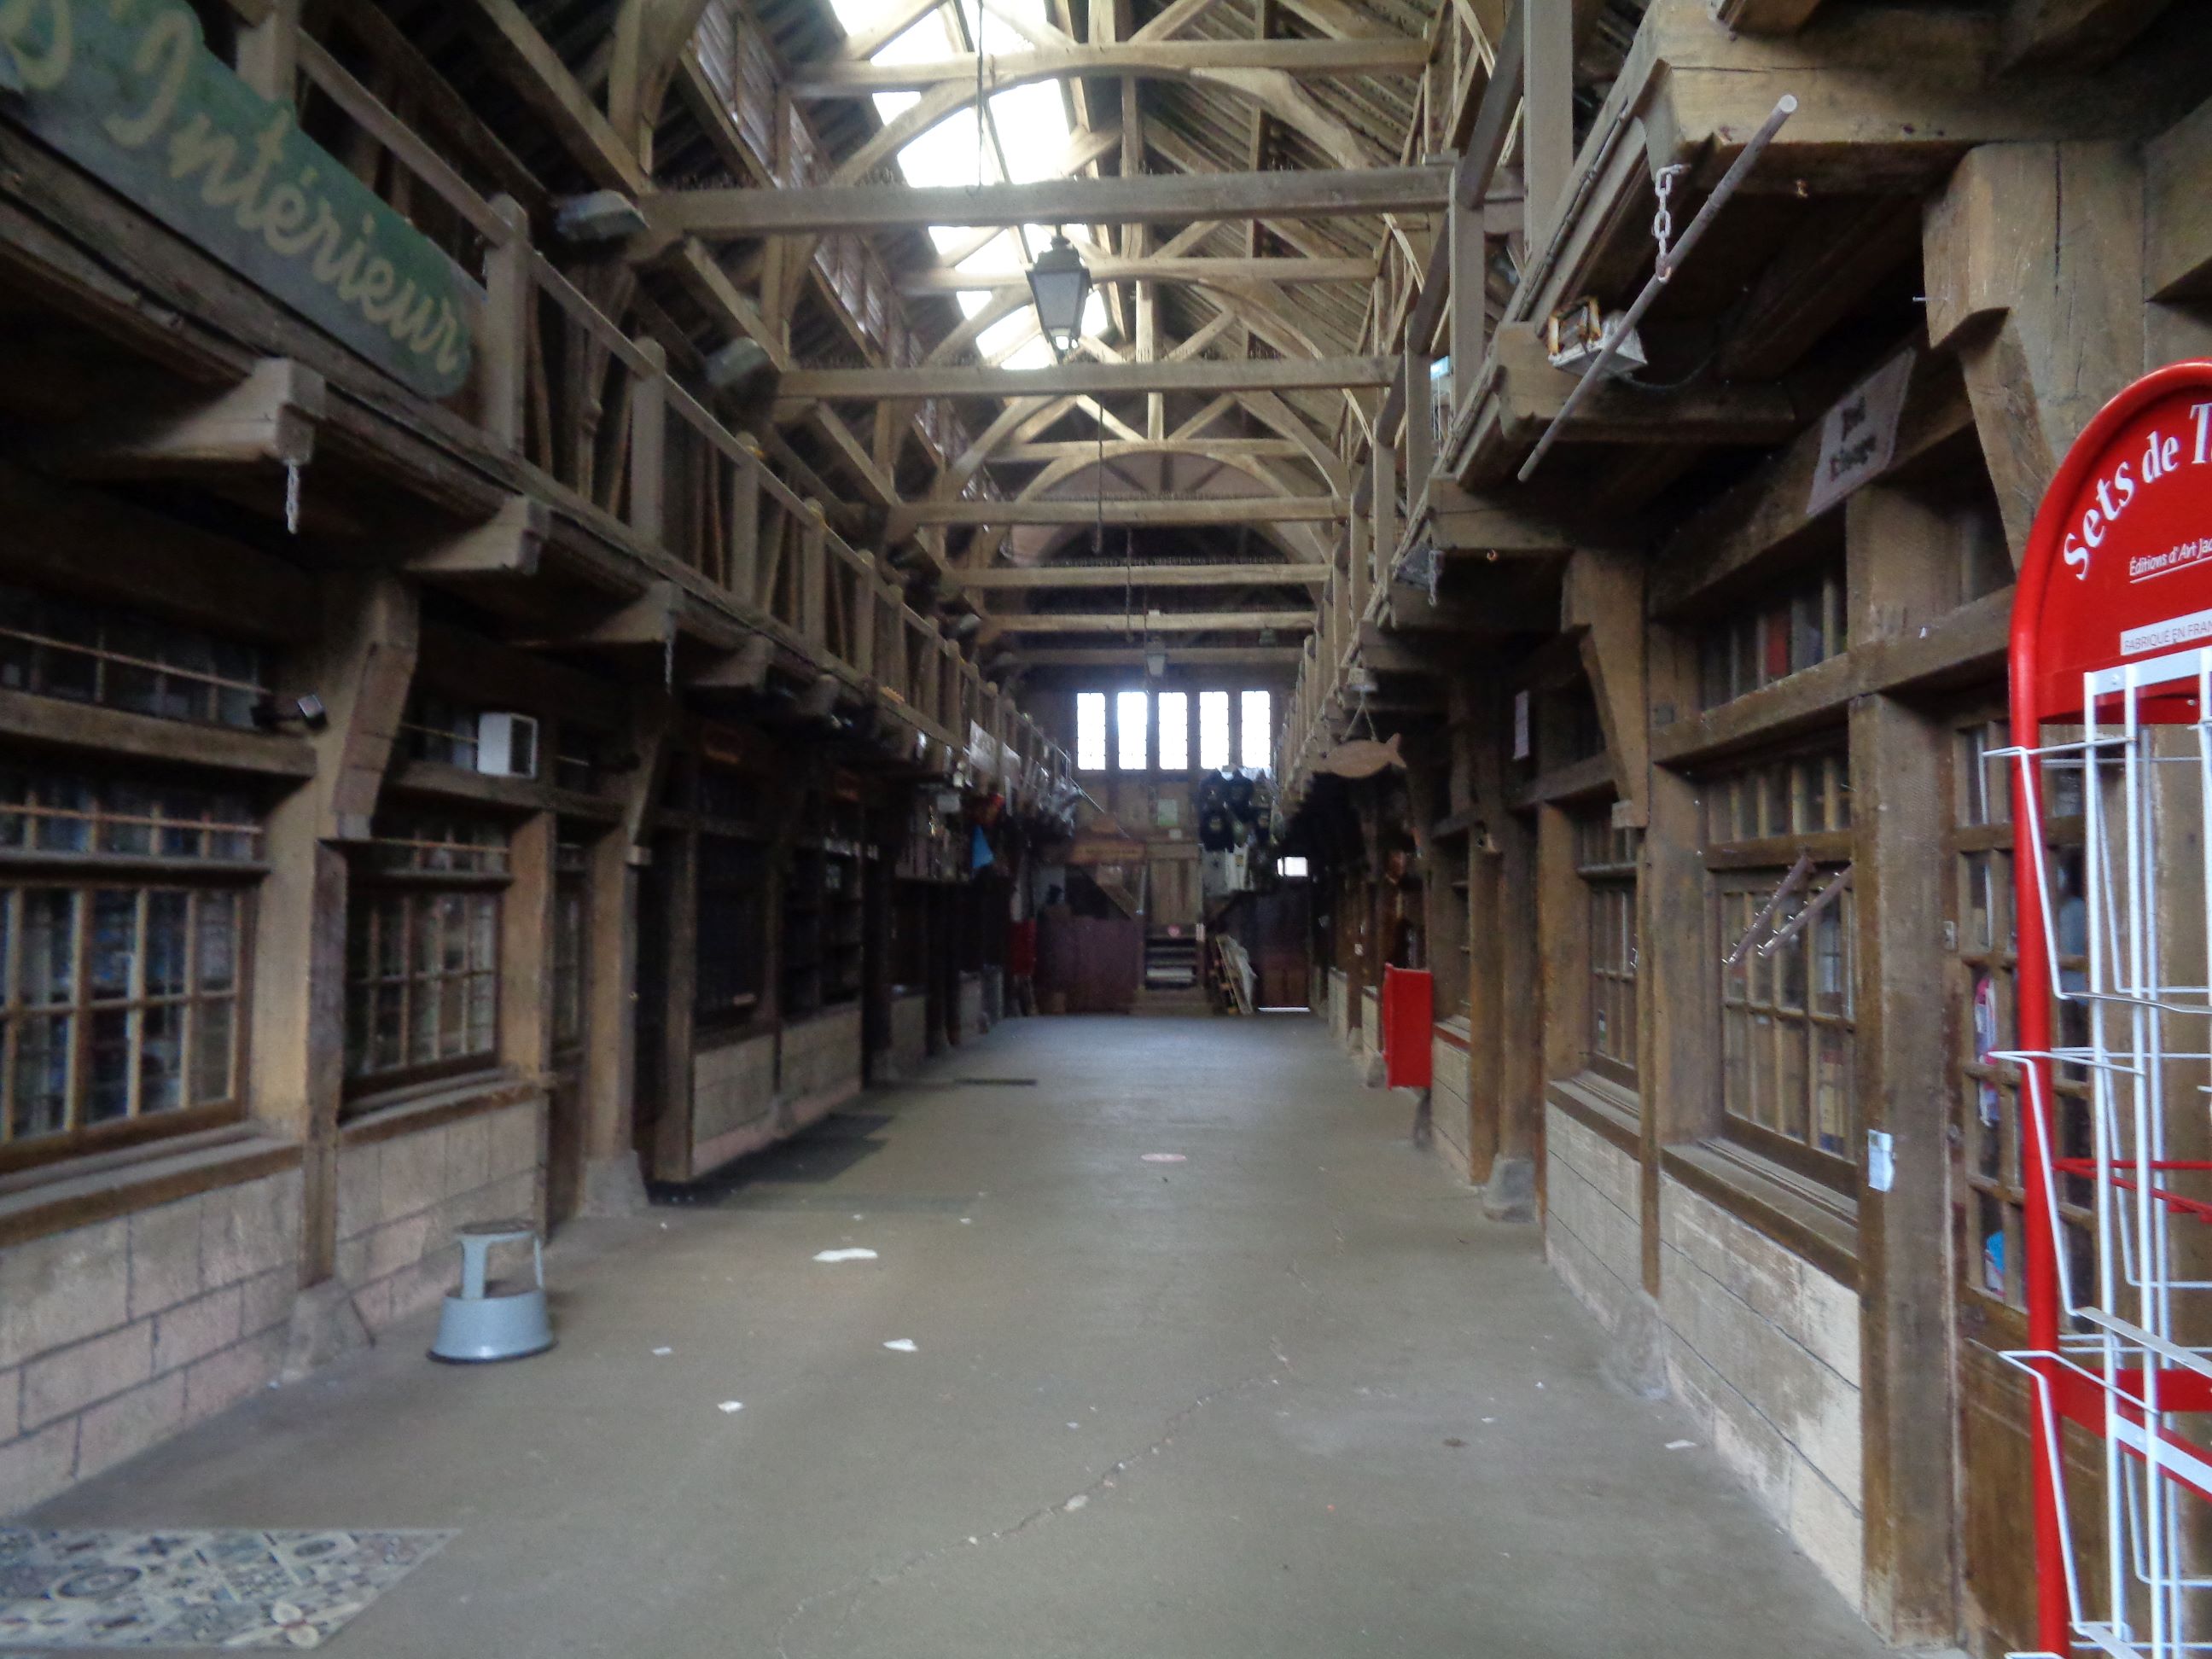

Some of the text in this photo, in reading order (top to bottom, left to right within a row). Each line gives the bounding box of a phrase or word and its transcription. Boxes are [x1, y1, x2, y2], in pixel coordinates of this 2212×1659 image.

[2064, 402, 2212, 580] Sets de T
